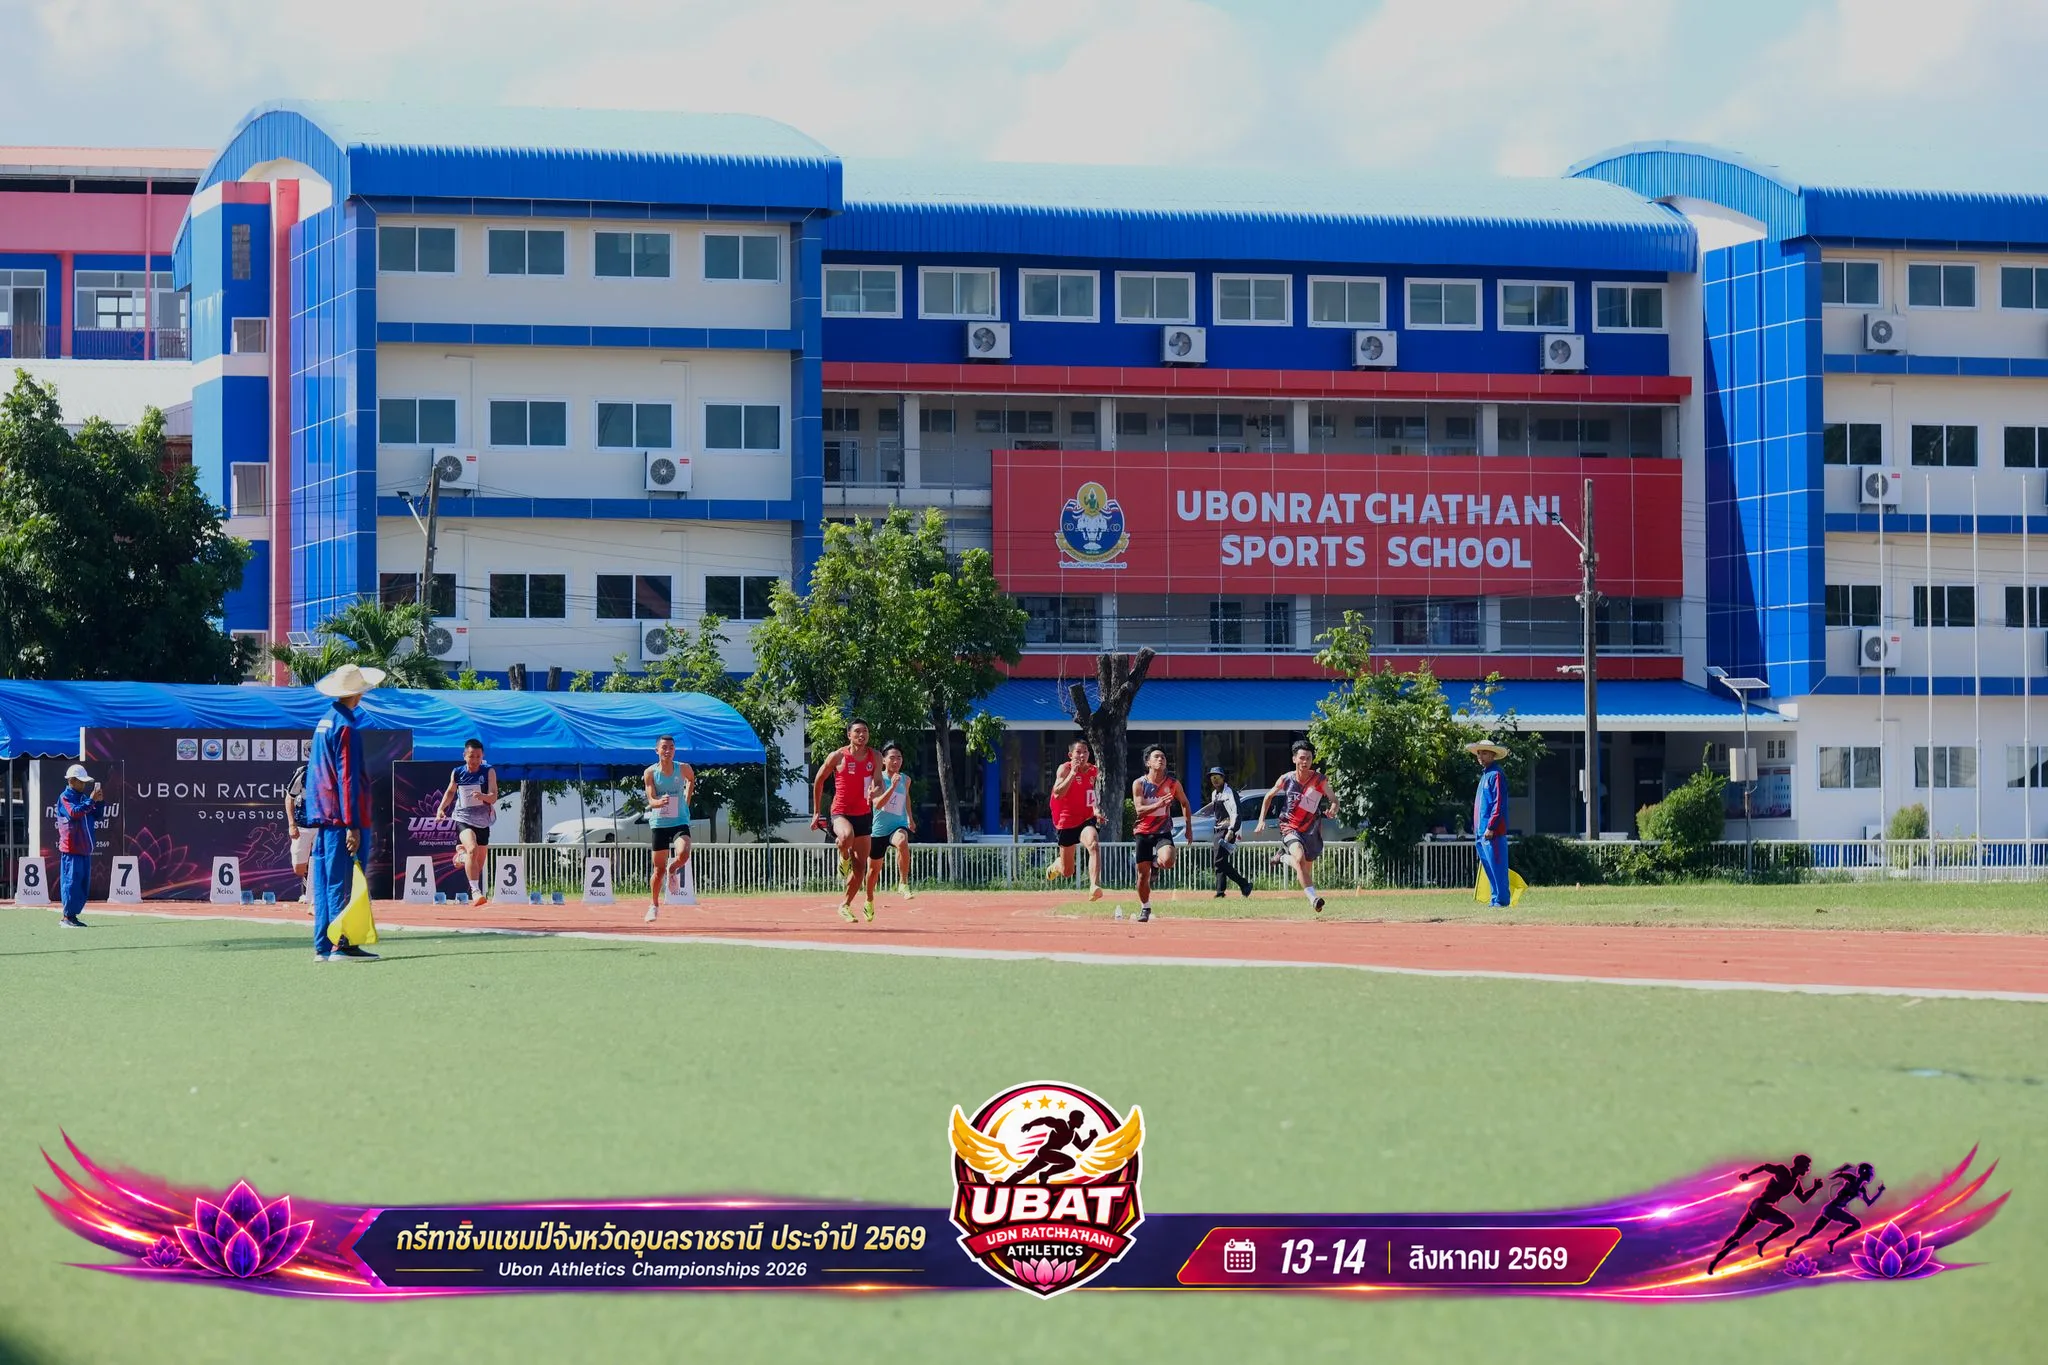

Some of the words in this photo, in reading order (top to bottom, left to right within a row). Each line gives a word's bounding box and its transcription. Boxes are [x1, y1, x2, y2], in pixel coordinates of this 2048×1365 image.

[1177, 490, 1560, 526] UBONRATCHATHANI
[1222, 534, 1366, 567] SPORTS
[1388, 536, 1532, 568] SCHOOL
[137, 783, 206, 798] UBON
[217, 783, 285, 798] RATCH
[24, 864, 40, 887] 8
[117, 864, 133, 887] 7
[218, 862, 234, 886] 6
[412, 864, 428, 887] 4
[503, 863, 517, 887] 3
[590, 865, 605, 888] 2
[676, 864, 686, 888] 1
